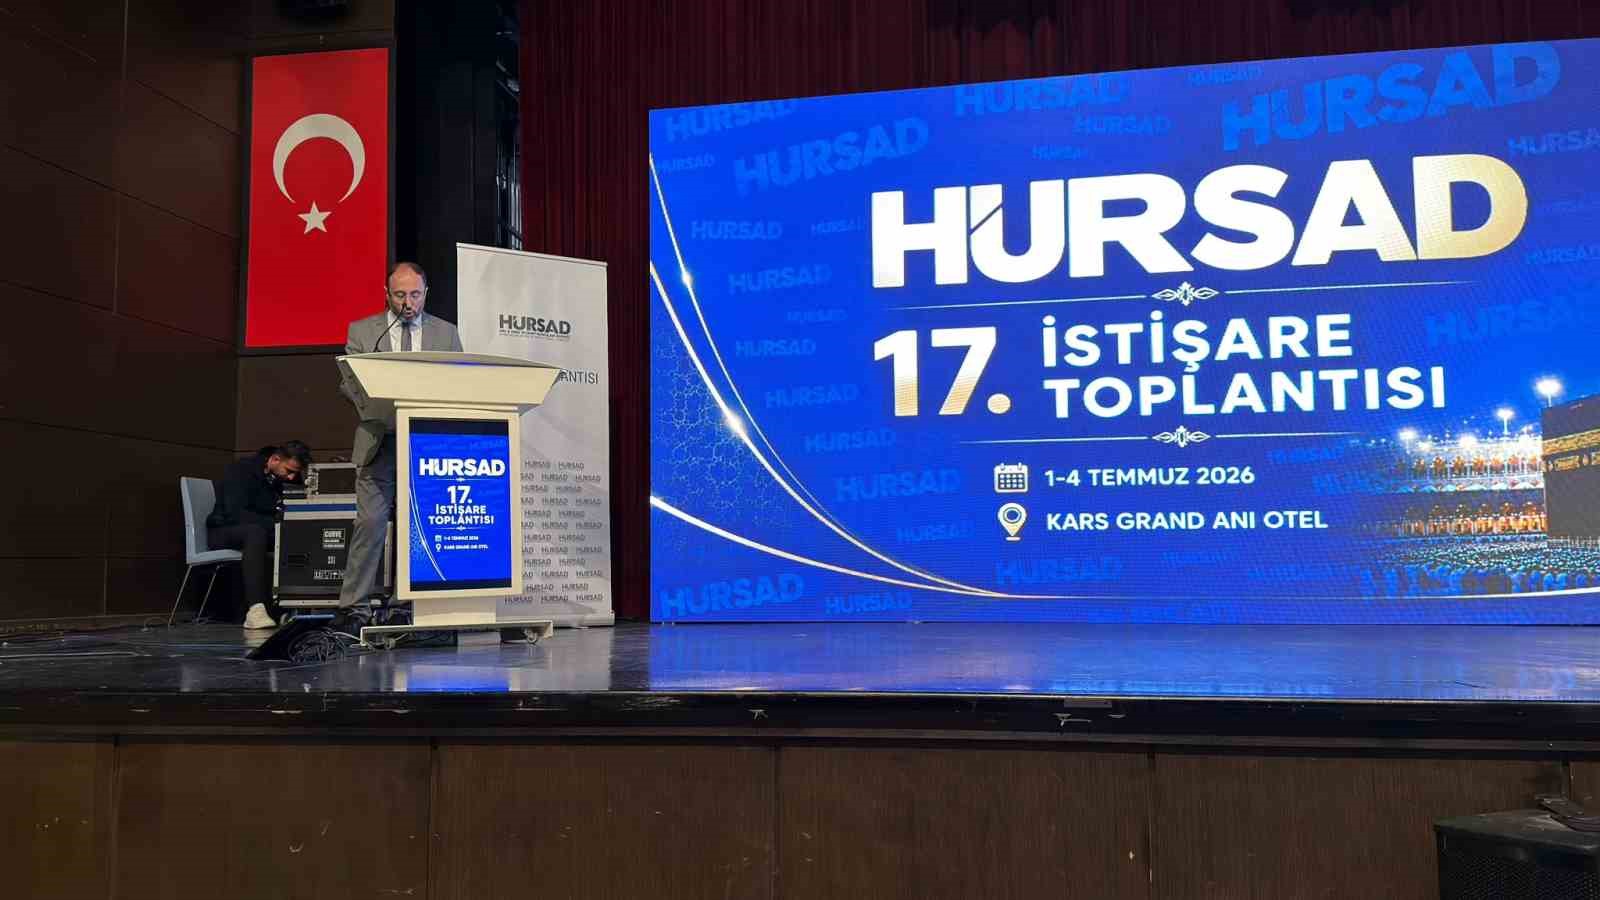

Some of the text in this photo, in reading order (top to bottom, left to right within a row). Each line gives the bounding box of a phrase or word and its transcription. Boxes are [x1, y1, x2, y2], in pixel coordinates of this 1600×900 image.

[1221, 42, 1561, 152] HURSAD
[733, 117, 929, 196] HURSAD
[690, 219, 783, 241] HURSAD
[871, 154, 1528, 288] HURSAD
[728, 263, 832, 294] HURSAD
[499, 314, 571, 335] HURSAD
[1042, 310, 1353, 371] İSTİŞARE
[873, 326, 1011, 417] 17.
[1044, 366, 1445, 419] TOPLANTISI
[419, 458, 506, 477] HURSAD
[1045, 467, 1255, 486] 1-4 TEMMUZ 2026
[447, 485, 472, 504] 17.
[428, 515, 494, 525] TOPLANTISI
[1047, 510, 1328, 530] KARS GRAND ANI OTEL
[659, 572, 805, 618] HURSAD
